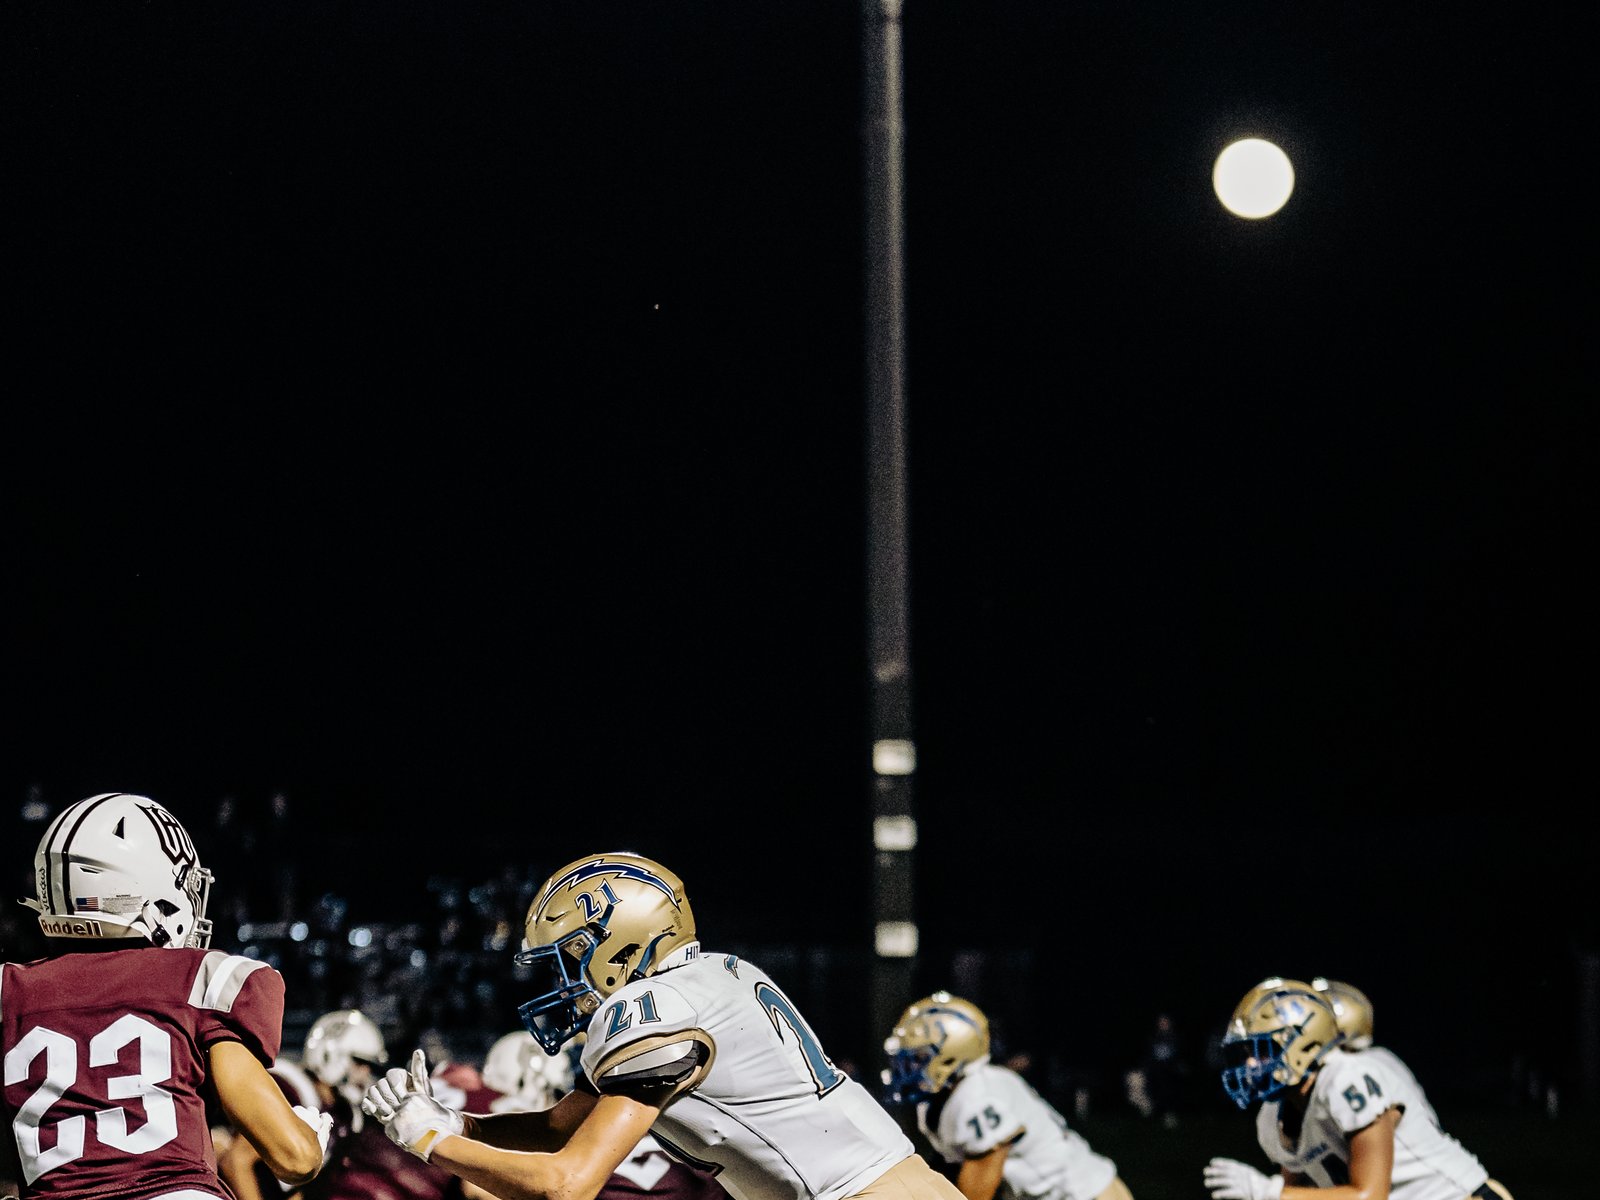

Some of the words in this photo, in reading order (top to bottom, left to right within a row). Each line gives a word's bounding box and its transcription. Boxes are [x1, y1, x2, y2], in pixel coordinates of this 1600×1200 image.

[574, 877, 622, 923] 21
[40, 918, 103, 937] Riddell
[604, 990, 661, 1043] 21
[4, 1013, 178, 1187] 23
[1343, 1073, 1383, 1113] 54
[966, 1104, 1002, 1140] 75
